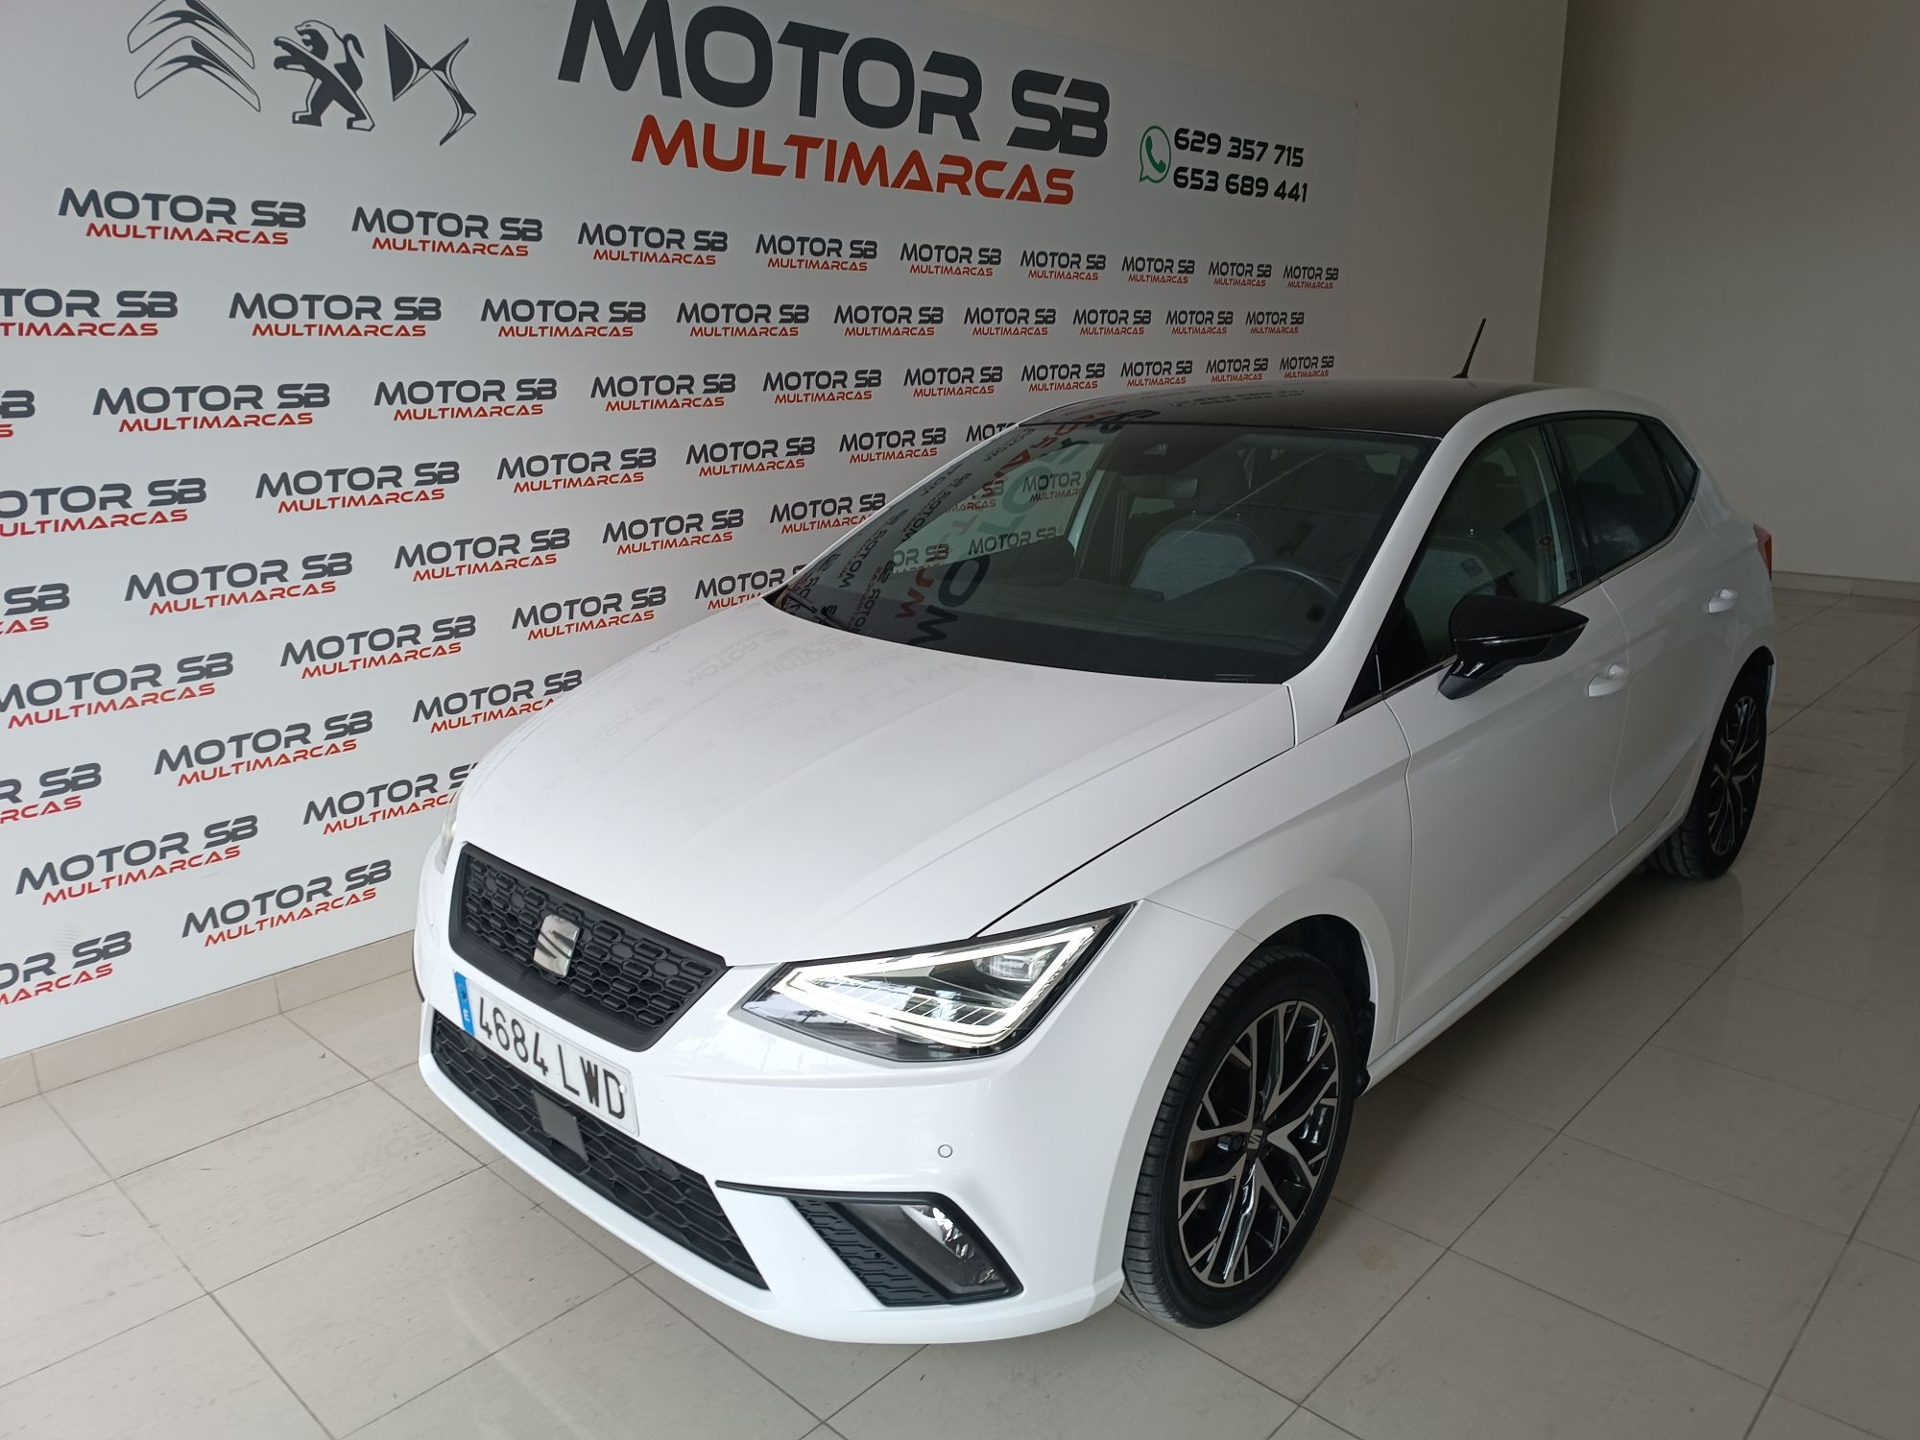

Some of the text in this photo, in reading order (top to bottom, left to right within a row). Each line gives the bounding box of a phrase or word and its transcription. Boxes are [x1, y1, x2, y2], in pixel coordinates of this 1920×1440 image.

[557, 0, 1110, 158] MOTOR SB
[1174, 127, 1305, 168] 629 357 715
[631, 114, 1075, 205] MULTIMARCAS
[1173, 166, 1308, 203] 653 689 441
[58, 188, 306, 228] MOTOR SB
[87, 223, 289, 245] MULTIMARCAS
[352, 207, 542, 242] MOTOR SB
[372, 238, 528, 257] MULTIMARCAS
[578, 222, 728, 252] MOTOR SB
[756, 234, 877, 259] MOTOR SB
[594, 249, 716, 265] MULTIMARCAS
[900, 243, 1001, 265] MOTOR SB
[1020, 250, 1106, 270] MOTOR SB
[1122, 256, 1195, 274] MOTOR SB
[768, 259, 868, 272] MULTIMARCAS
[911, 265, 993, 277] MULTIMARCAS
[1029, 270, 1098, 281] MULTIMARCAS
[1208, 261, 1272, 278] MOTOR SB
[1283, 265, 1339, 280] MOTOR SB
[1129, 274, 1188, 284] MULTIMARCAS
[1215, 278, 1265, 287] MULTIMARCAS
[1289, 282, 1333, 290] MULTIMARCAS
[117, 291, 178, 318] SB
[229, 293, 441, 321] MOTOR SB
[481, 299, 646, 322] MOTOR SB
[677, 303, 809, 323] MOTOR SB
[834, 305, 943, 324] MOTOR SB
[964, 307, 1056, 324] MOTOR SB
[1073, 309, 1151, 325] MOTOR SB
[1166, 310, 1233, 325] MOTOR SB
[1246, 311, 1304, 325] MOTOR SB
[253, 323, 426, 338] MULTIMARCAS
[499, 326, 633, 338] MULTIMARCAS
[690, 326, 798, 337] MULTIMARCAS
[845, 327, 935, 337] MULTIMARCAS
[973, 327, 1048, 336] MULTIMARCAS
[1080, 326, 1145, 335] MULTIMARCAS
[1172, 327, 1228, 335] MULTIMARCAS
[1251, 326, 1298, 334] MULTIMARCAS
[1021, 363, 1105, 381] MOTOR SB
[1121, 361, 1192, 377] MOTOR SB
[1206, 358, 1268, 373] MOTOR SB
[1280, 356, 1334, 370] MOTOR SB
[1284, 370, 1329, 378] MULTIMARCAS
[591, 374, 736, 398] MOTOR SB
[763, 369, 881, 391] MOTOR SB
[904, 366, 1003, 386] MOTOR SB
[1030, 381, 1098, 392] MULTIMARCAS
[1127, 377, 1188, 387] MULTIMARCAS
[1212, 373, 1263, 383] MULTIMARCAS
[93, 383, 330, 415] MOTOR SB
[374, 378, 557, 405] MOTOR SB
[775, 390, 872, 403] MULTIMARCAS
[914, 385, 996, 397] MULTIMARCAS
[395, 404, 543, 421] MULTIMARCAS
[606, 396, 724, 411] MULTIMARCAS
[120, 412, 312, 432] MULTIMARCAS
[965, 422, 1016, 443] MOT
[686, 437, 815, 464] MOTOR SB
[839, 428, 946, 452] MOTOR SB
[497, 448, 656, 480] MOTOR SB
[850, 448, 937, 463] MULTIMARCAS
[699, 459, 805, 476] MULTIMARCAS
[256, 461, 459, 498] MOTOR SB
[514, 472, 644, 492] MULTIMARCAS
[148, 478, 206, 507] SB
[279, 488, 445, 513] MULTIMARCAS
[770, 493, 885, 523] MOTOR SB
[0, 509, 188, 538] ULTIMARCAS
[603, 509, 743, 543] MOTOR SB
[394, 528, 570, 569] MOTOR SB
[617, 531, 733, 554] MULTIMARCAS
[125, 552, 352, 601] MOTOR SB
[414, 554, 557, 581] MULTIMARCAS
[695, 568, 785, 600] MOTOR
[4, 583, 69, 616] SB
[150, 581, 336, 615] MULTIMARCAS
[512, 586, 666, 629] MOTOR SB
[529, 611, 654, 640] MULTIMARCAS
[281, 615, 475, 666] MOTOR SB
[303, 642, 461, 678] MULTIMARCAS
[0, 652, 233, 712] MOTOR SB
[9, 683, 215, 729] MULTIMARCAS
[413, 670, 582, 722] MOTOR SB
[154, 711, 372, 775] MOTOR SB
[178, 739, 357, 786] MULTIMARCAS
[39, 763, 101, 798] SB
[303, 774, 438, 825] MOTOR
[16, 815, 257, 895] MOTOR SB
[43, 846, 240, 905] MULTIMARCAS
[182, 860, 391, 938] MOTOR SB
[205, 888, 376, 947] MULTIMARCAS
[72, 931, 131, 969] SB
[480, 997, 626, 1120] 4684 LWD
